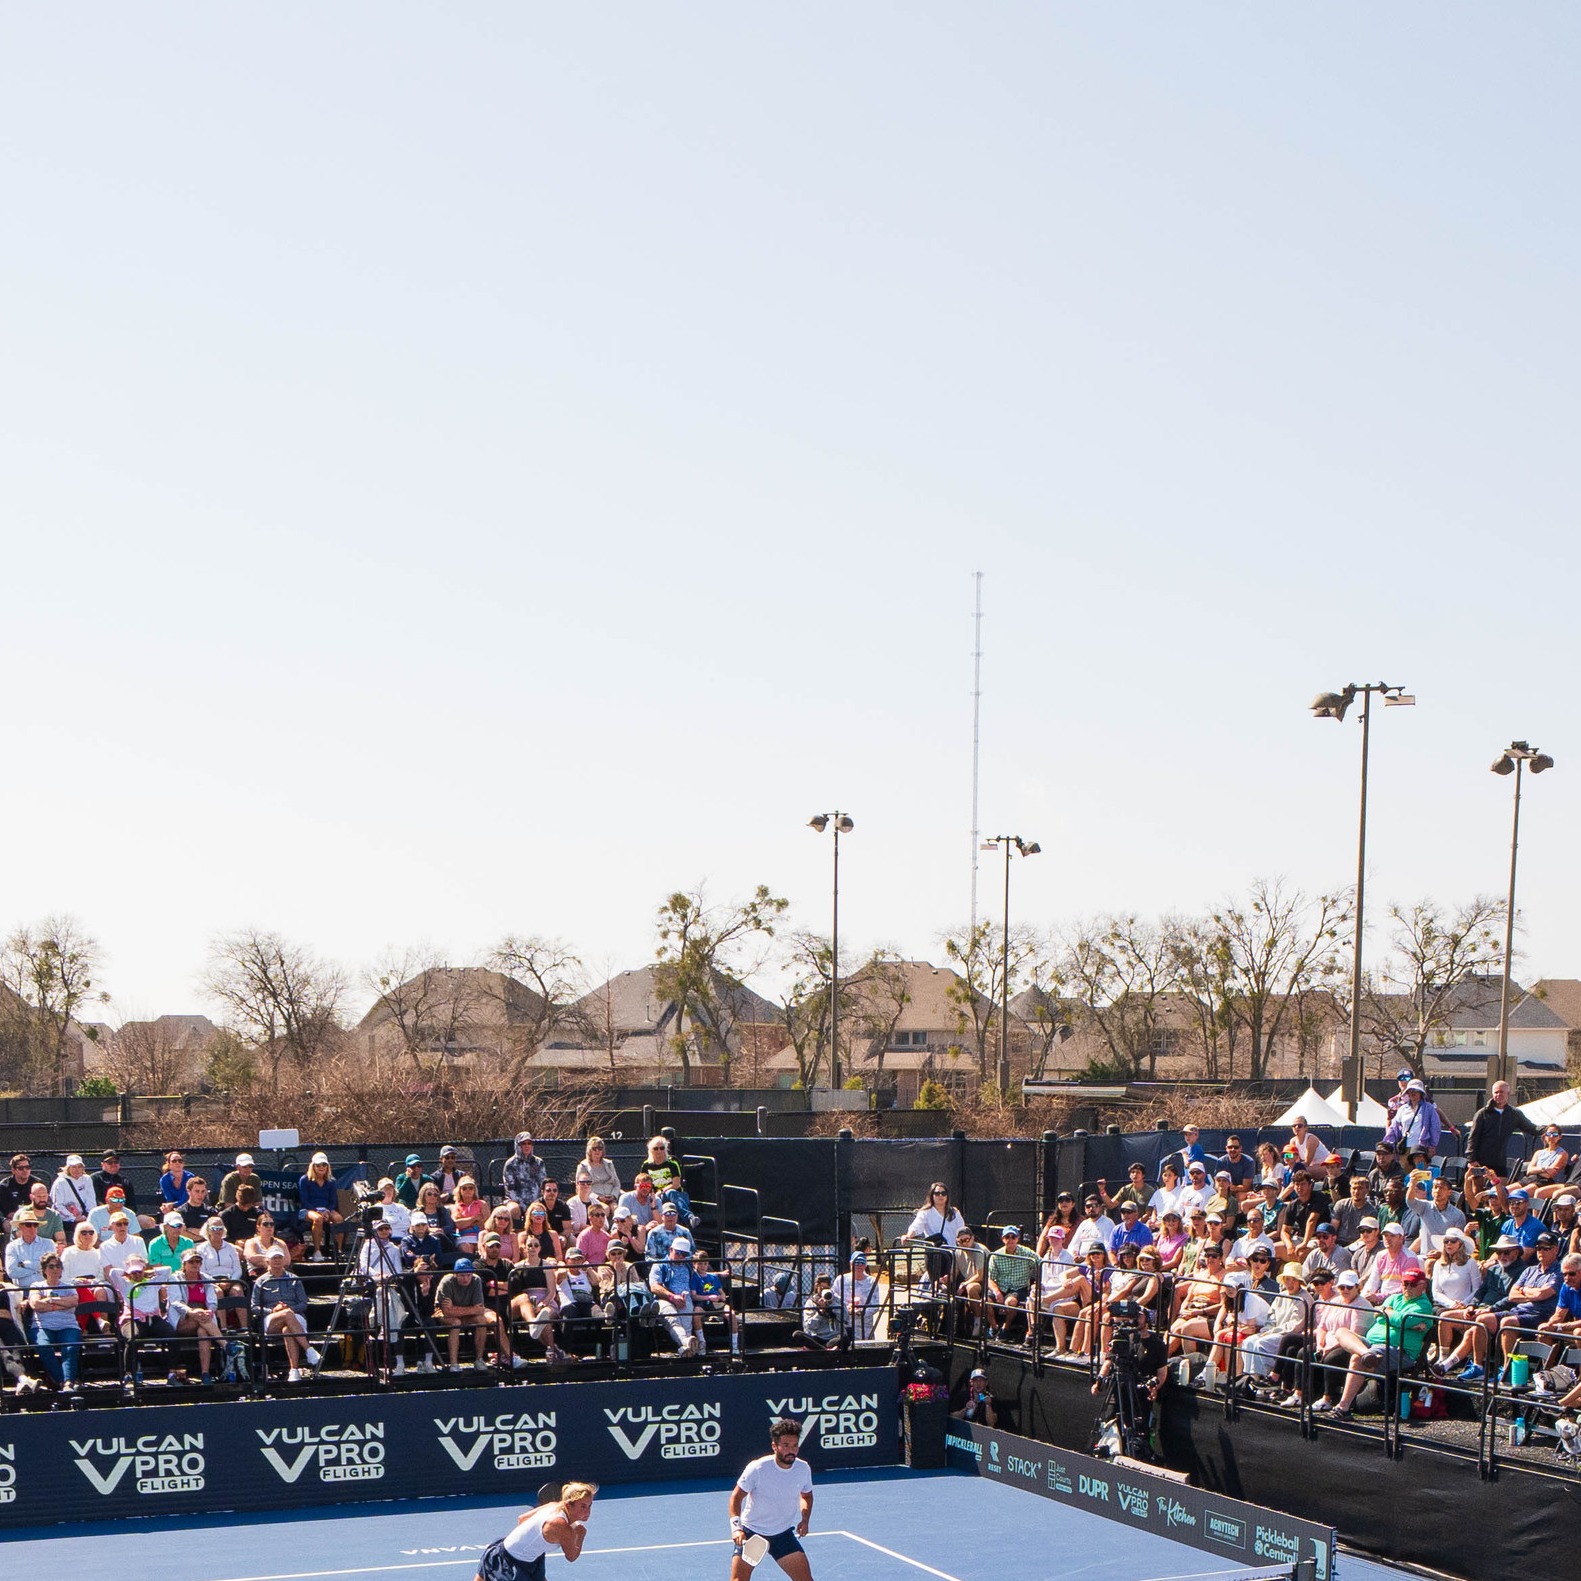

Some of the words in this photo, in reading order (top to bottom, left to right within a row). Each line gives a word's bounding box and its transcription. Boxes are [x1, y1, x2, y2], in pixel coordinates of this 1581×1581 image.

[603, 1402, 721, 1424] VULCAN
[766, 1393, 878, 1415] VULCAN
[255, 1422, 385, 1446] VULCAN
[434, 1412, 556, 1434] VULCAN
[69, 1433, 204, 1456] VULCAN
[663, 1444, 718, 1457] FLIGHT
[823, 1434, 875, 1447] FLIGHT
[497, 1454, 554, 1467] FLIGHT
[140, 1477, 202, 1491] FLIGHT
[322, 1466, 382, 1480] FLIGHT
[1079, 1474, 1109, 1501] DUPR
[1117, 1482, 1149, 1499] VULCAN
[1256, 1525, 1299, 1551] Pickleball
